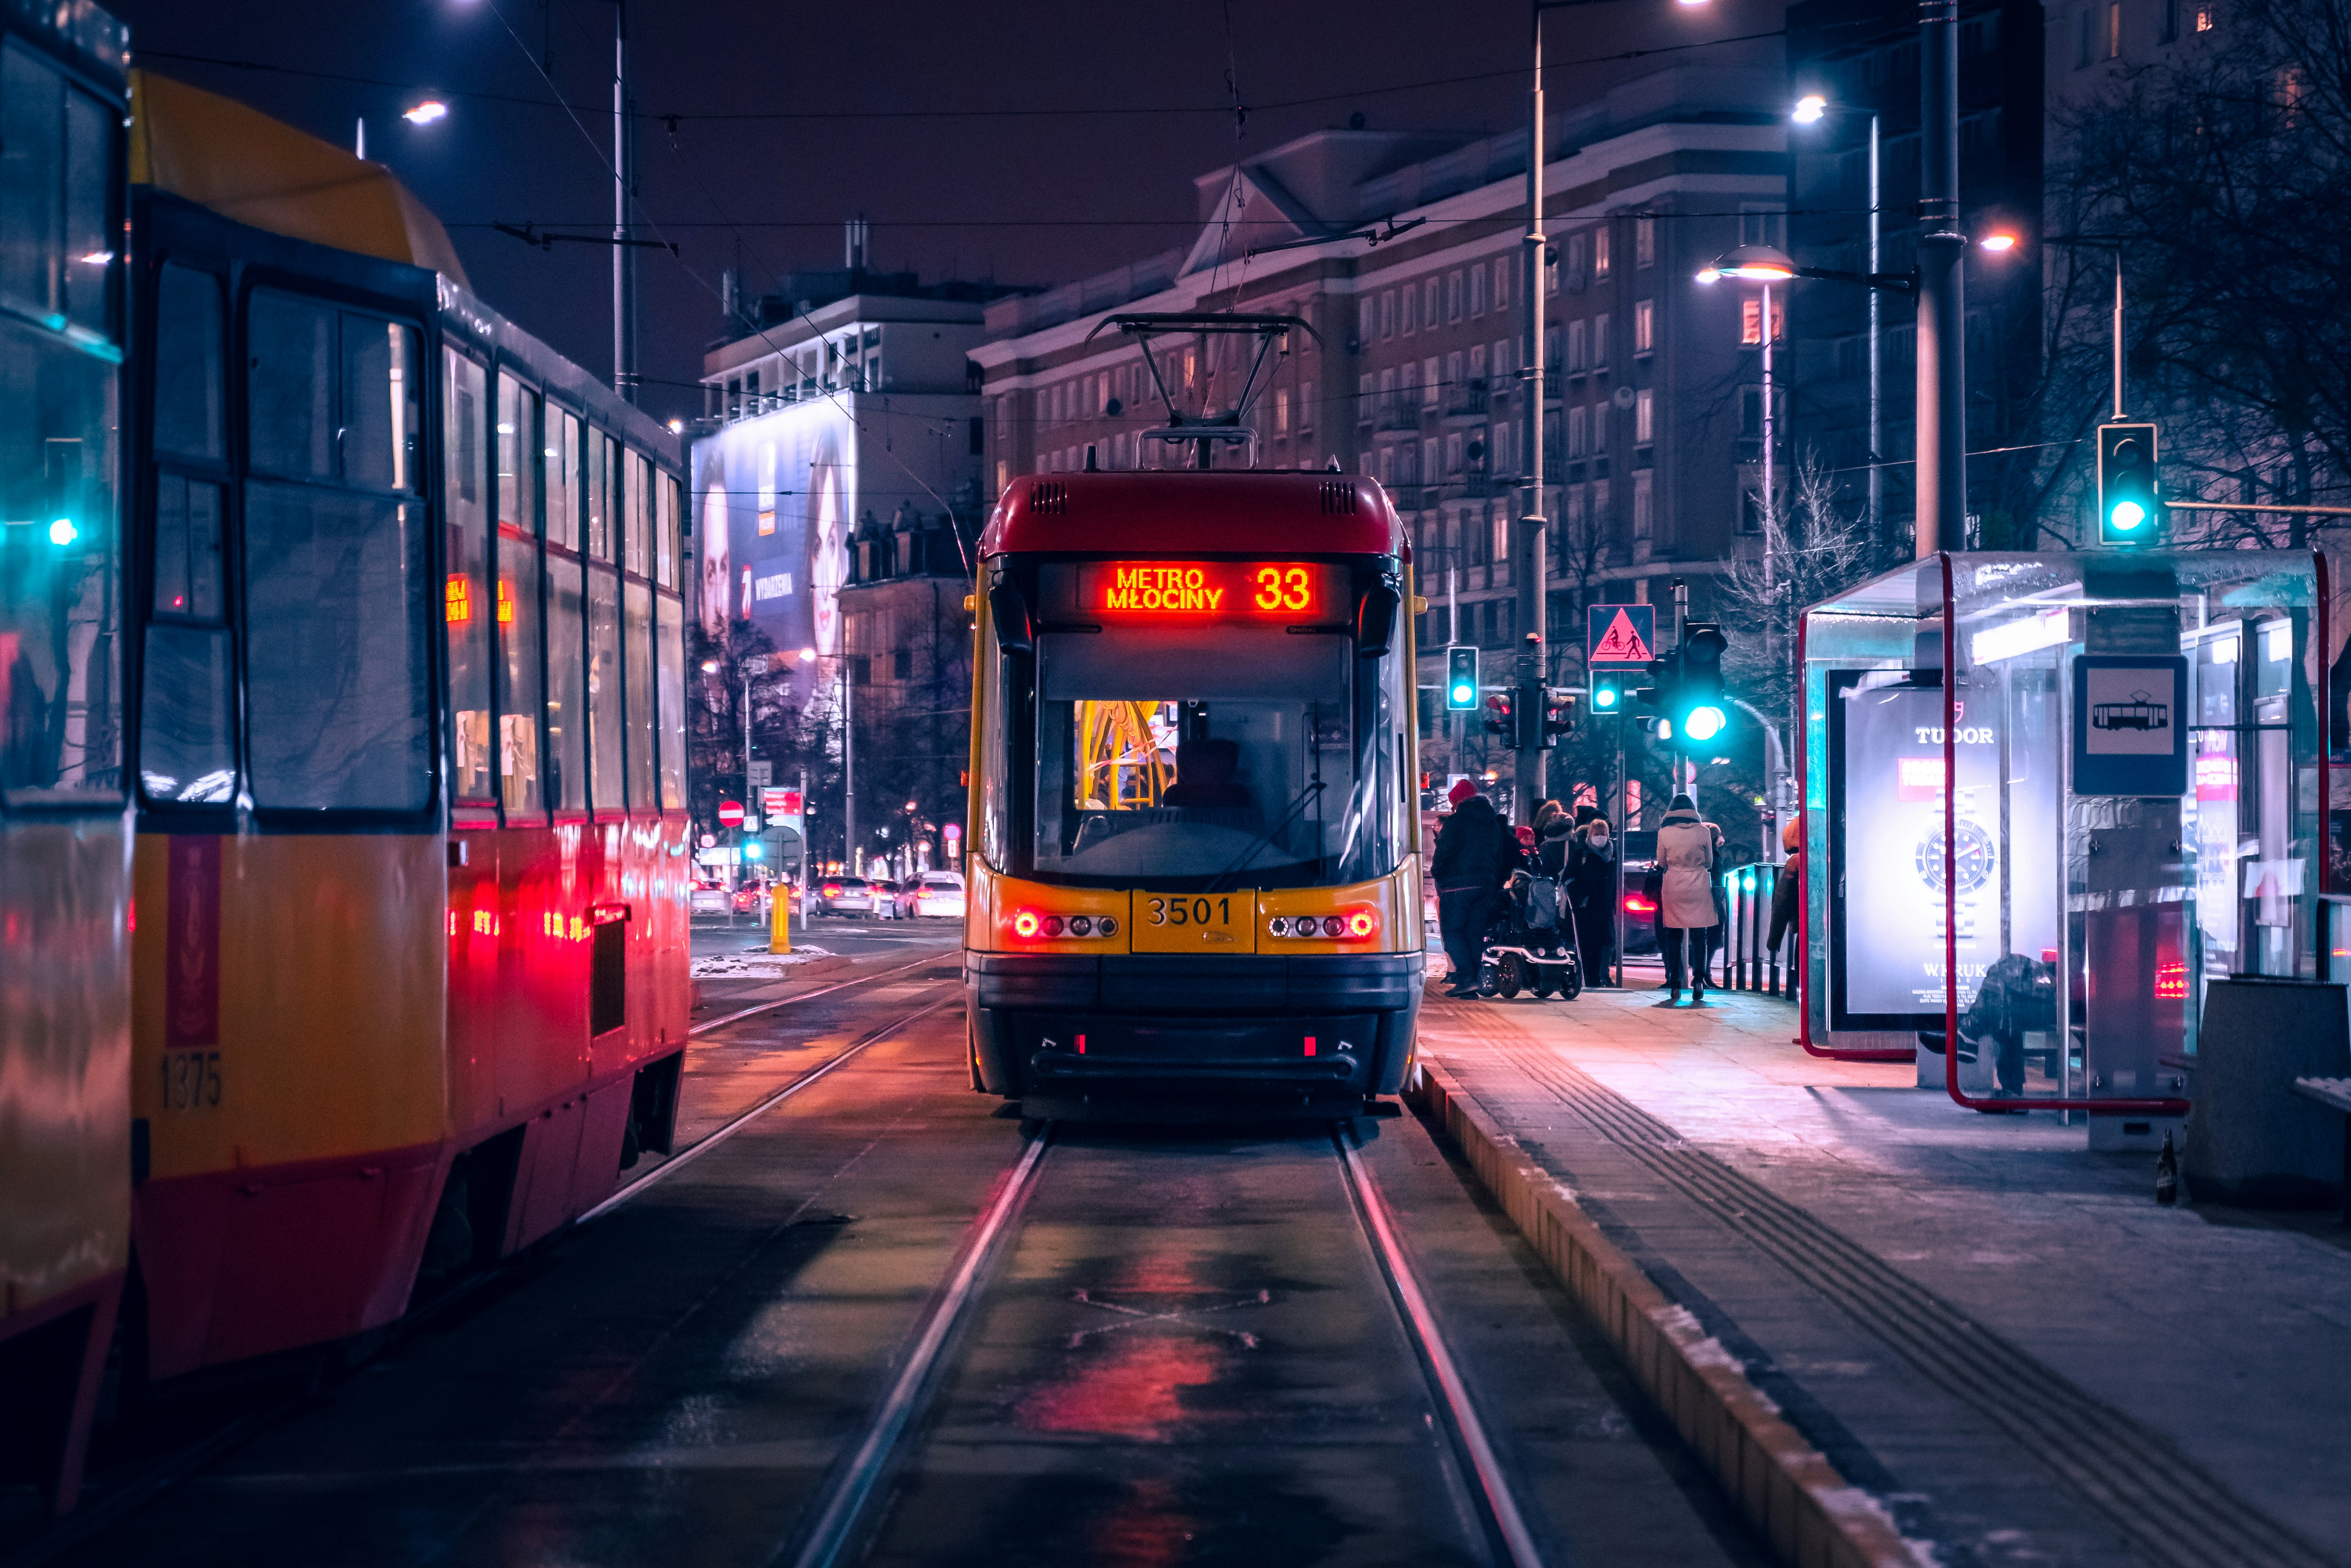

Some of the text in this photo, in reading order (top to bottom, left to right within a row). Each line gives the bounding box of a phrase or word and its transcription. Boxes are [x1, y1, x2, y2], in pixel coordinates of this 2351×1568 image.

[1117, 568, 1203, 589] METRO
[1255, 568, 1310, 610] 33
[1107, 588, 1222, 609] MŁOCINY
[1915, 727, 1994, 745] TUDOR
[1147, 897, 1229, 927] 3501
[160, 1052, 220, 1110] 1375
